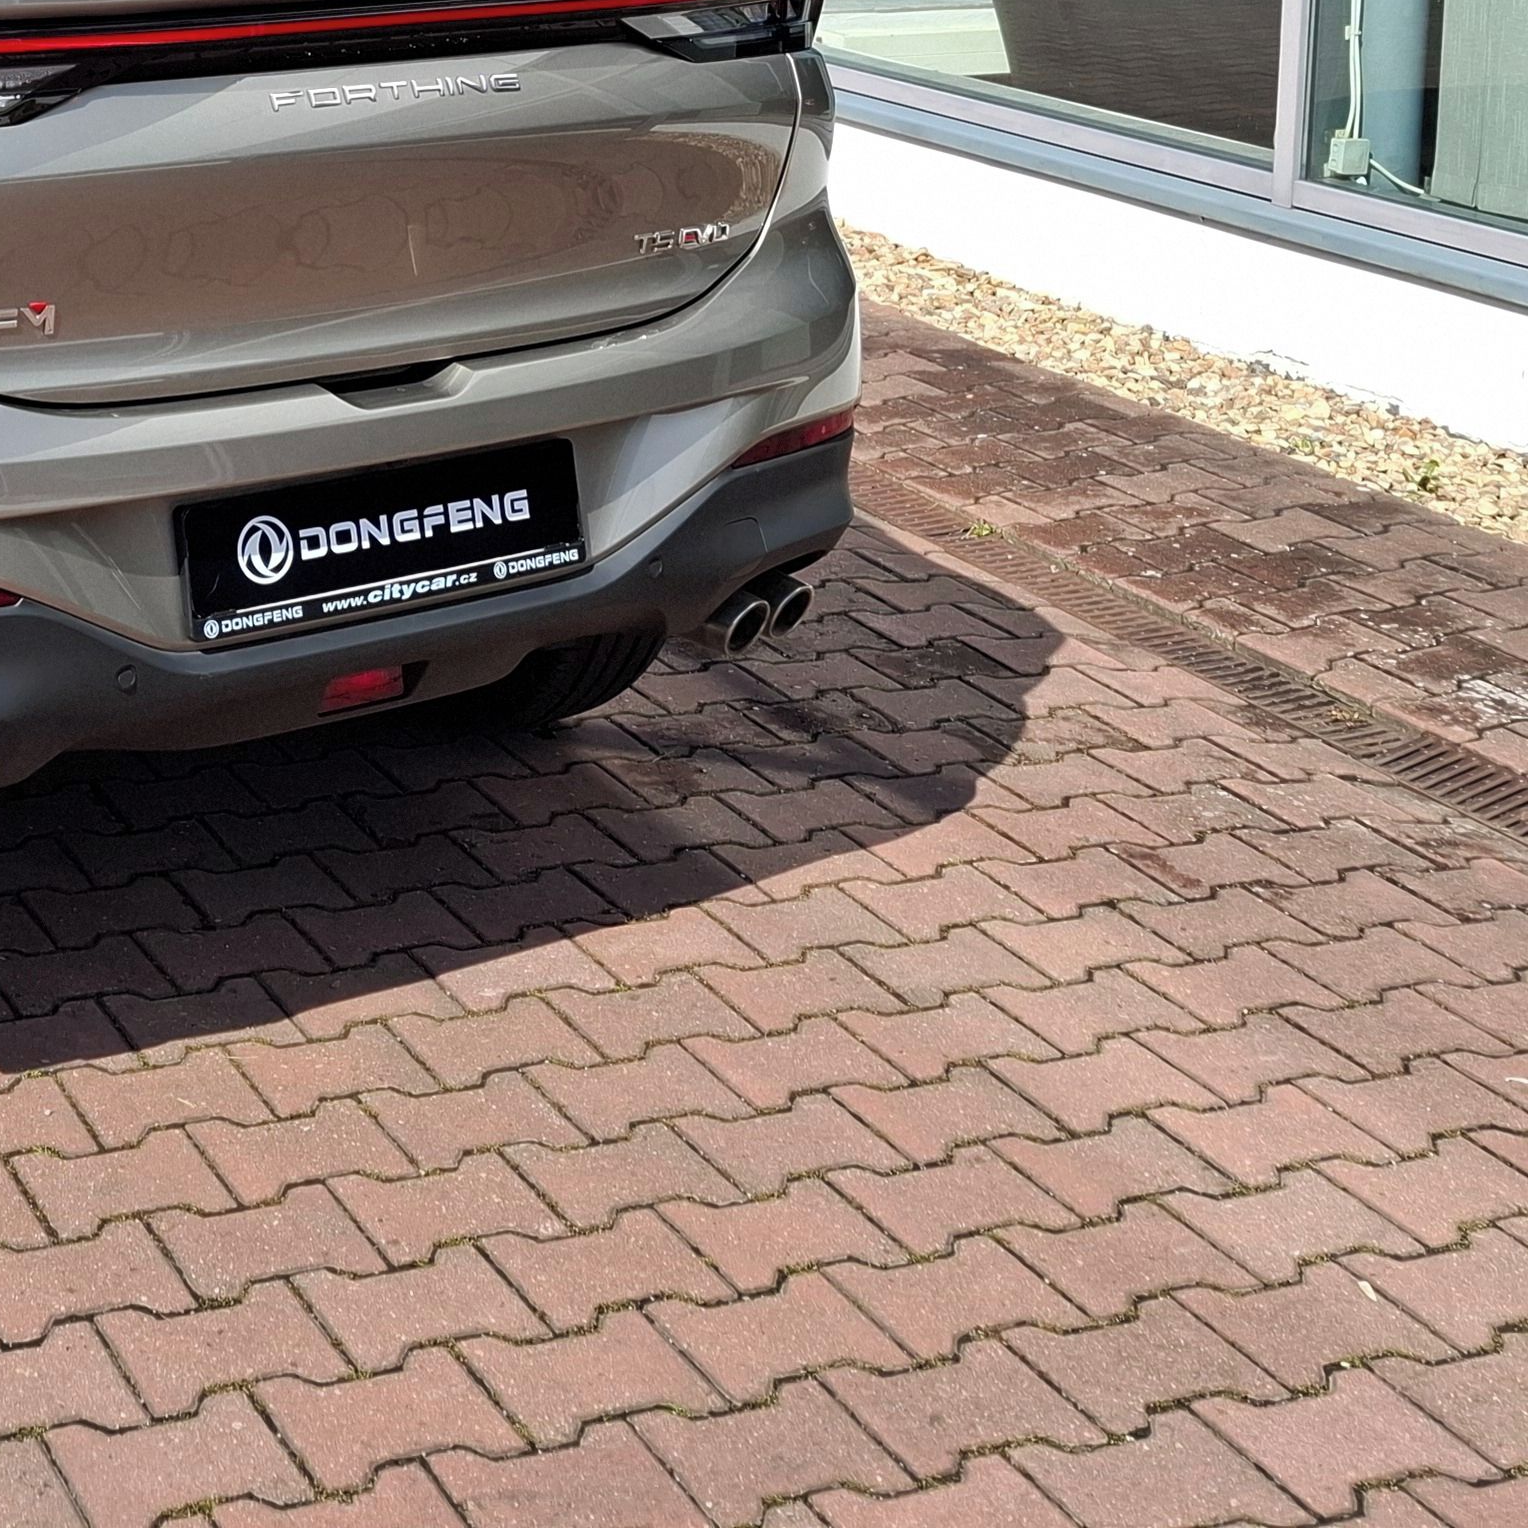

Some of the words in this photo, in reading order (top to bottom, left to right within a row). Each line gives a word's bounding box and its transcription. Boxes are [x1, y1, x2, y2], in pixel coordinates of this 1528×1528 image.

[269, 73, 521, 111] FORTHING
[299, 489, 531, 560] DONGFENG
[508, 548, 579, 574] DONGFENG
[322, 571, 478, 614] www.citycar.cz
[221, 605, 303, 634] DONGFENG
